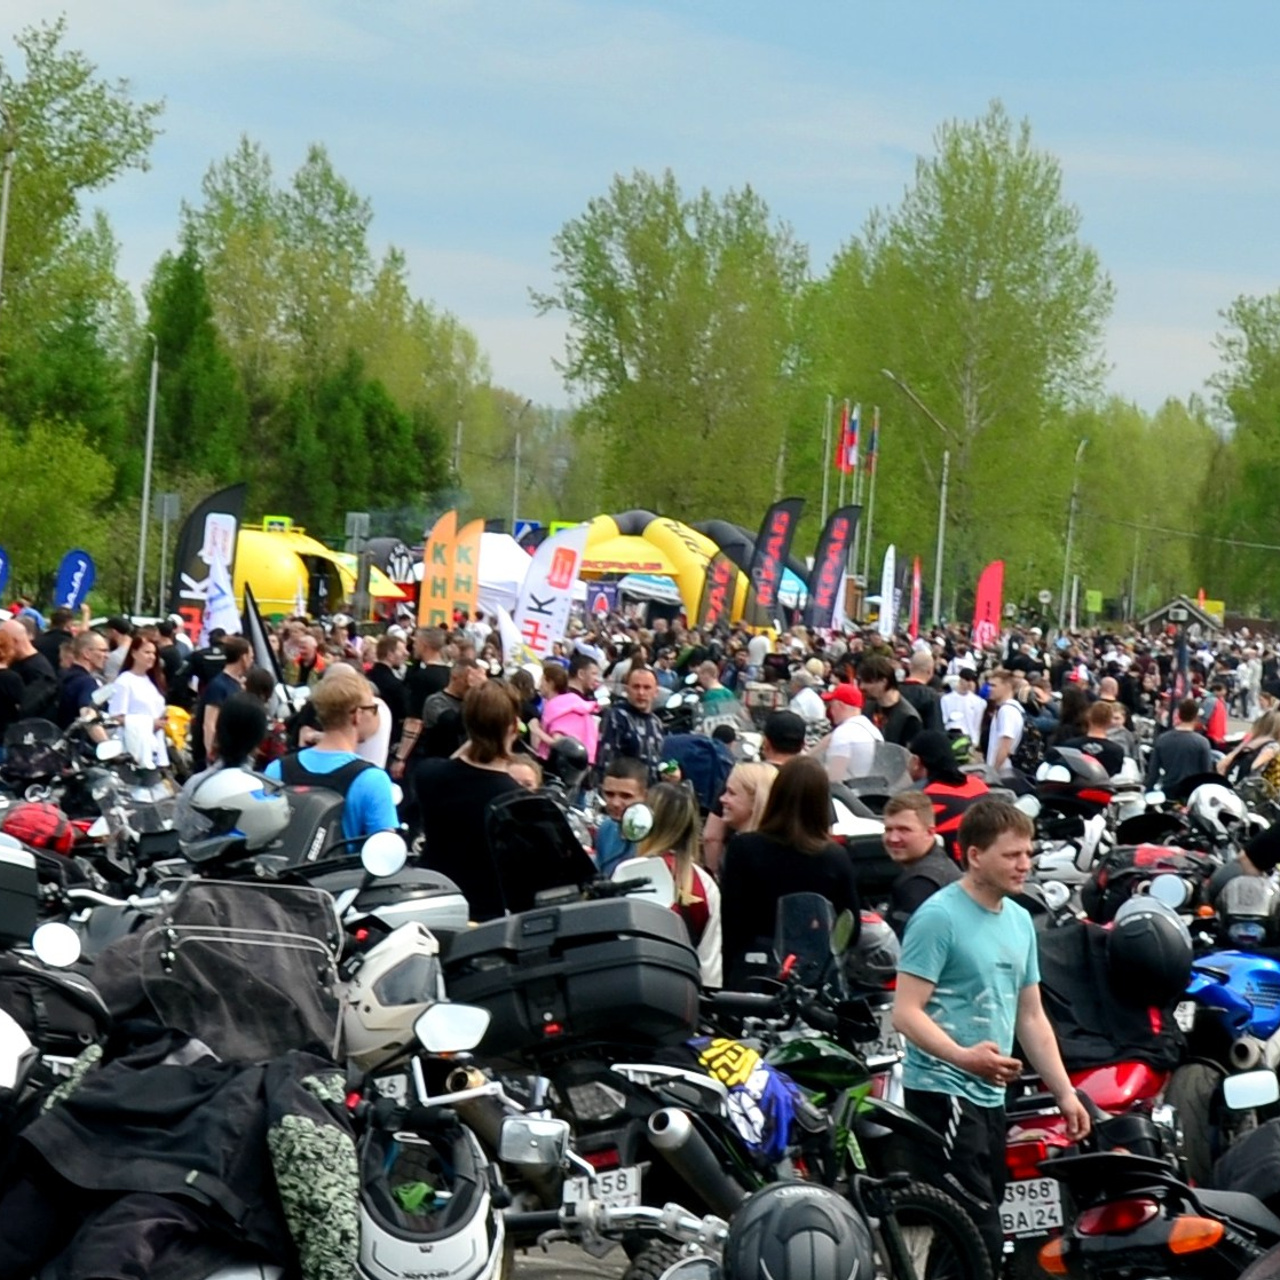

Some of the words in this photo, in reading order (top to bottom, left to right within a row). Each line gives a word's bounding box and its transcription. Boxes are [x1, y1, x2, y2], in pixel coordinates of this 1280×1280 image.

[1004, 1181, 1050, 1203] 3968
[1002, 1211, 1029, 1230] BA
[1035, 1207, 1059, 1226] 24
